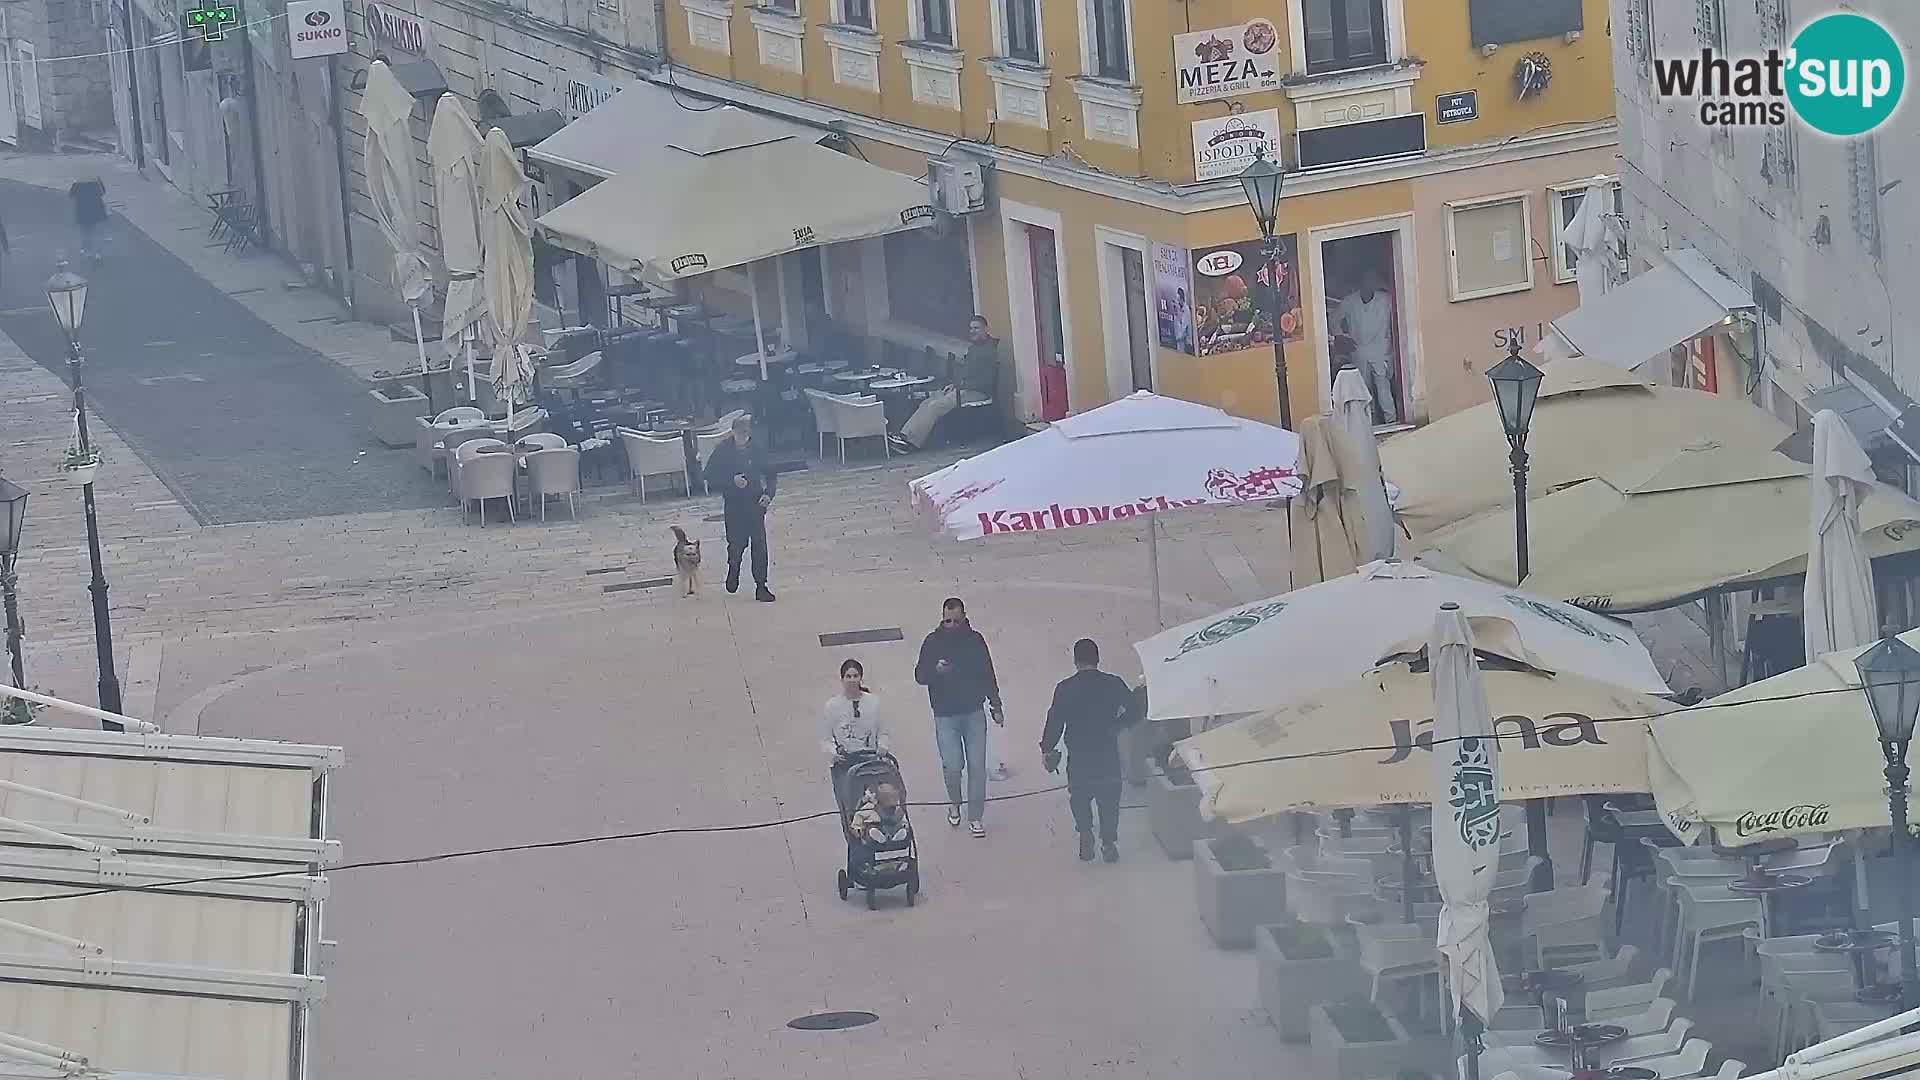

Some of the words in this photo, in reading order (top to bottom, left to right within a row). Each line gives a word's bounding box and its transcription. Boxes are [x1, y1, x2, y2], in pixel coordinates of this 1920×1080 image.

[297, 28, 342, 42] SUKNO
[383, 12, 422, 51] SUKNO
[1180, 58, 1259, 89] MEZA
[1189, 85, 1222, 97] PIZZERIA
[1223, 85, 1229, 93] &
[1229, 80, 1251, 92] GRILL
[1198, 144, 1245, 163] ISPOD
[1736, 804, 1832, 837] Coca-Cola
